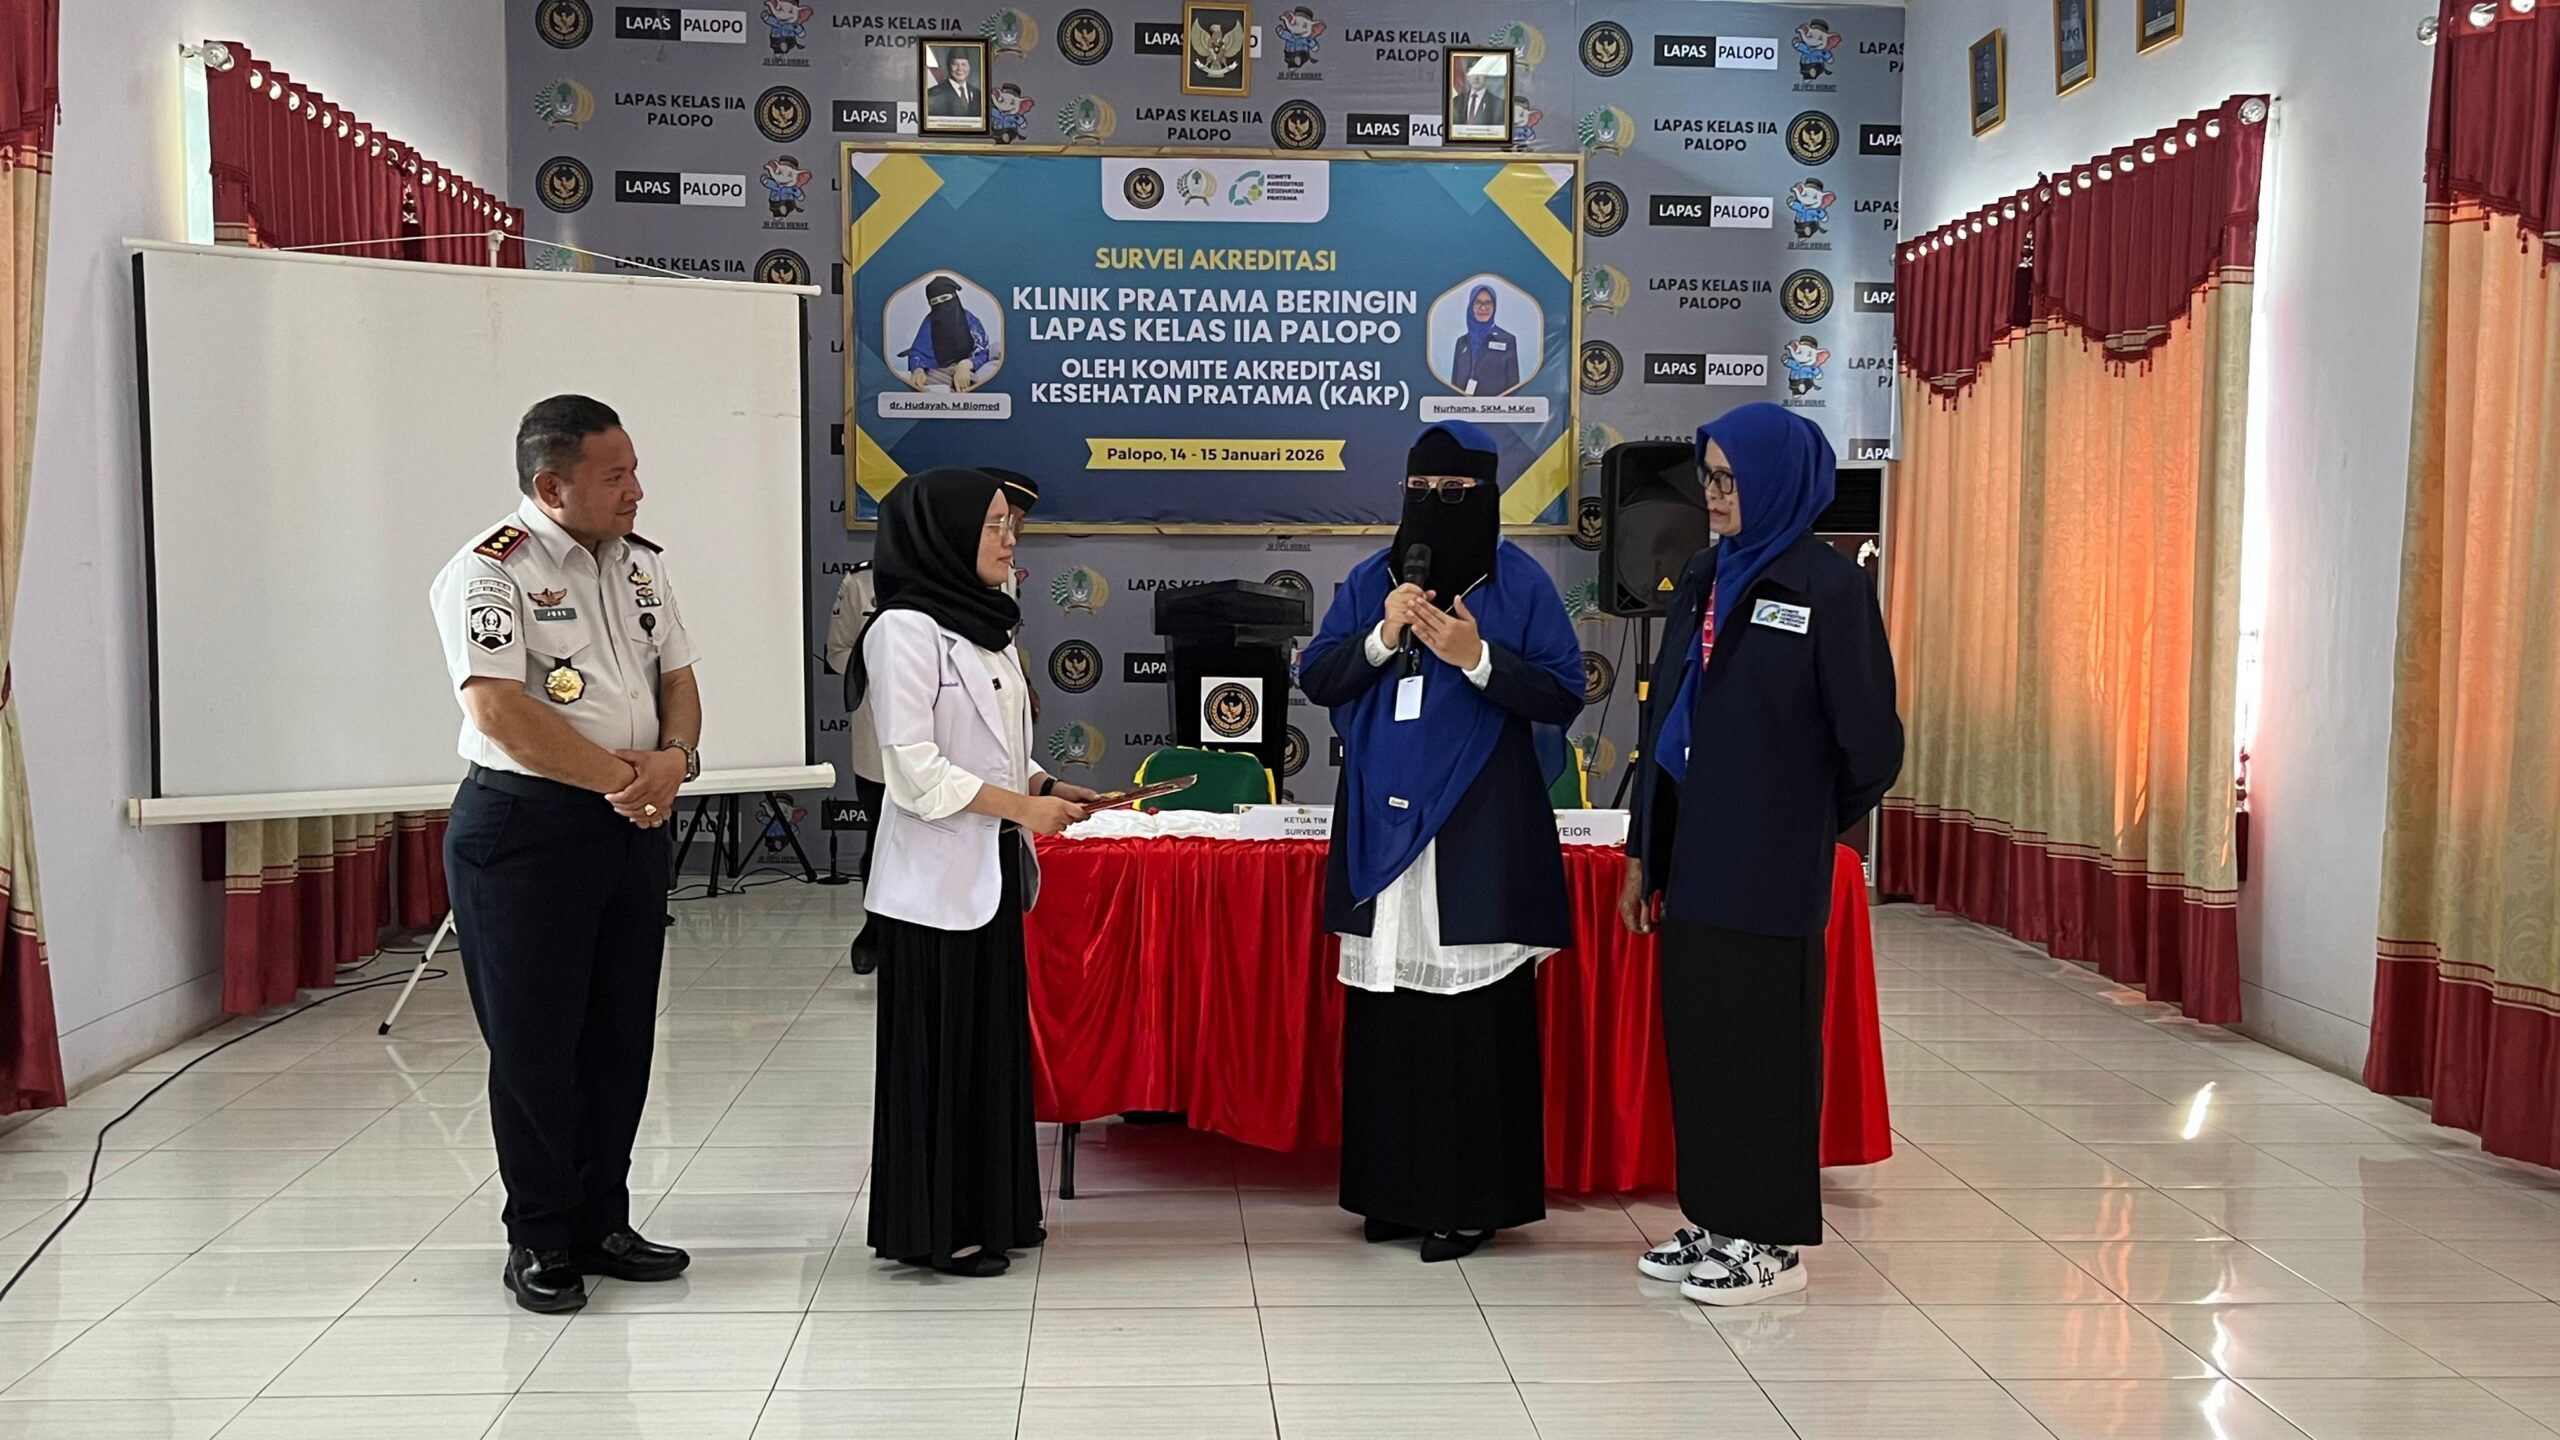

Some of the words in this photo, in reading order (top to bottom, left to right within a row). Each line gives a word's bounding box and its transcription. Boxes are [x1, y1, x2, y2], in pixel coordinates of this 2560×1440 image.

[626, 16, 671, 31] LAPAS
[684, 18, 743, 33] PALOPO
[833, 15, 884, 29] LAPAS
[888, 16, 937, 31] KELAS
[941, 17, 962, 32] IIA
[865, 34, 918, 48] PALOP
[1345, 29, 1395, 43] LAPAS
[1400, 30, 1447, 44] KELAS
[1451, 31, 1471, 44] IIA
[1376, 48, 1439, 62] PALOPO
[1663, 44, 1707, 58] LAPAS
[1718, 45, 1775, 60] PALOPO
[615, 93, 666, 108] LAPAS
[671, 95, 720, 109] KELAS
[724, 96, 745, 110] IIA
[648, 112, 713, 128] PALOPO
[843, 109, 887, 123] LAPAS
[1136, 108, 1186, 121] LAPAS
[1190, 110, 1238, 123] KELAS
[1243, 111, 1263, 124] IIA
[1356, 122, 1400, 136] LAPAS
[1654, 118, 1703, 132] LAPAS
[1707, 120, 1754, 134] KELAS
[1758, 122, 1778, 134] IIA
[1168, 128, 1231, 141] PALOPO
[1869, 134, 1902, 146] LAPA
[1684, 138, 1746, 152] PALOPO
[626, 180, 671, 195] LAPAS
[684, 182, 743, 197] PALOPO
[1659, 203, 1702, 218] LAPAS
[1714, 204, 1770, 220] PALOPO
[671, 257, 720, 272] KELAS
[724, 259, 745, 273] IIA
[1095, 248, 1184, 270] SURVEI
[1190, 249, 1336, 272] AKREDITASI
[1650, 278, 1698, 292] LAPAS
[1702, 279, 1749, 292] KELAS
[1752, 280, 1772, 293] IIA
[1013, 287, 1110, 311] KLINIK
[1119, 288, 1269, 313] PRATAMA
[1277, 289, 1417, 314] BERINGIN
[1680, 296, 1741, 310] PALOPO
[1864, 292, 1896, 304] LAPA
[1030, 317, 1127, 341] LAPAS
[1134, 318, 1227, 342] KELAS
[1234, 319, 1273, 342] IIA
[1281, 320, 1401, 344] PALOPO
[1061, 359, 1125, 380] OLEH
[1132, 359, 1228, 380] KOMITE
[1234, 360, 1381, 381] AKREDITASI
[1654, 362, 1697, 376] LAPAS
[1708, 362, 1764, 377] PALOPO
[1031, 384, 1181, 404] KESEHATAN
[1188, 384, 1313, 406] PRATAMA
[1320, 381, 1410, 411] (KAKP)
[890, 402, 902, 410] dr.
[952, 402, 1000, 411] M.Biomed
[1508, 405, 1536, 413] M.Kes
[1106, 448, 1166, 462] Palopo,
[1171, 448, 1186, 461] 14
[1201, 448, 1218, 462] 15
[1222, 448, 1281, 462] Januari
[1286, 449, 1325, 462] 2026
[1858, 448, 1891, 460] LAPA
[822, 562, 850, 575] LAP
[1128, 579, 1177, 591] LAPAS
[1134, 662, 1167, 674] LAPA
[820, 720, 851, 732] LAP
[1284, 816, 1311, 824] KETUA
[1286, 828, 1326, 836] SURVEIOR
